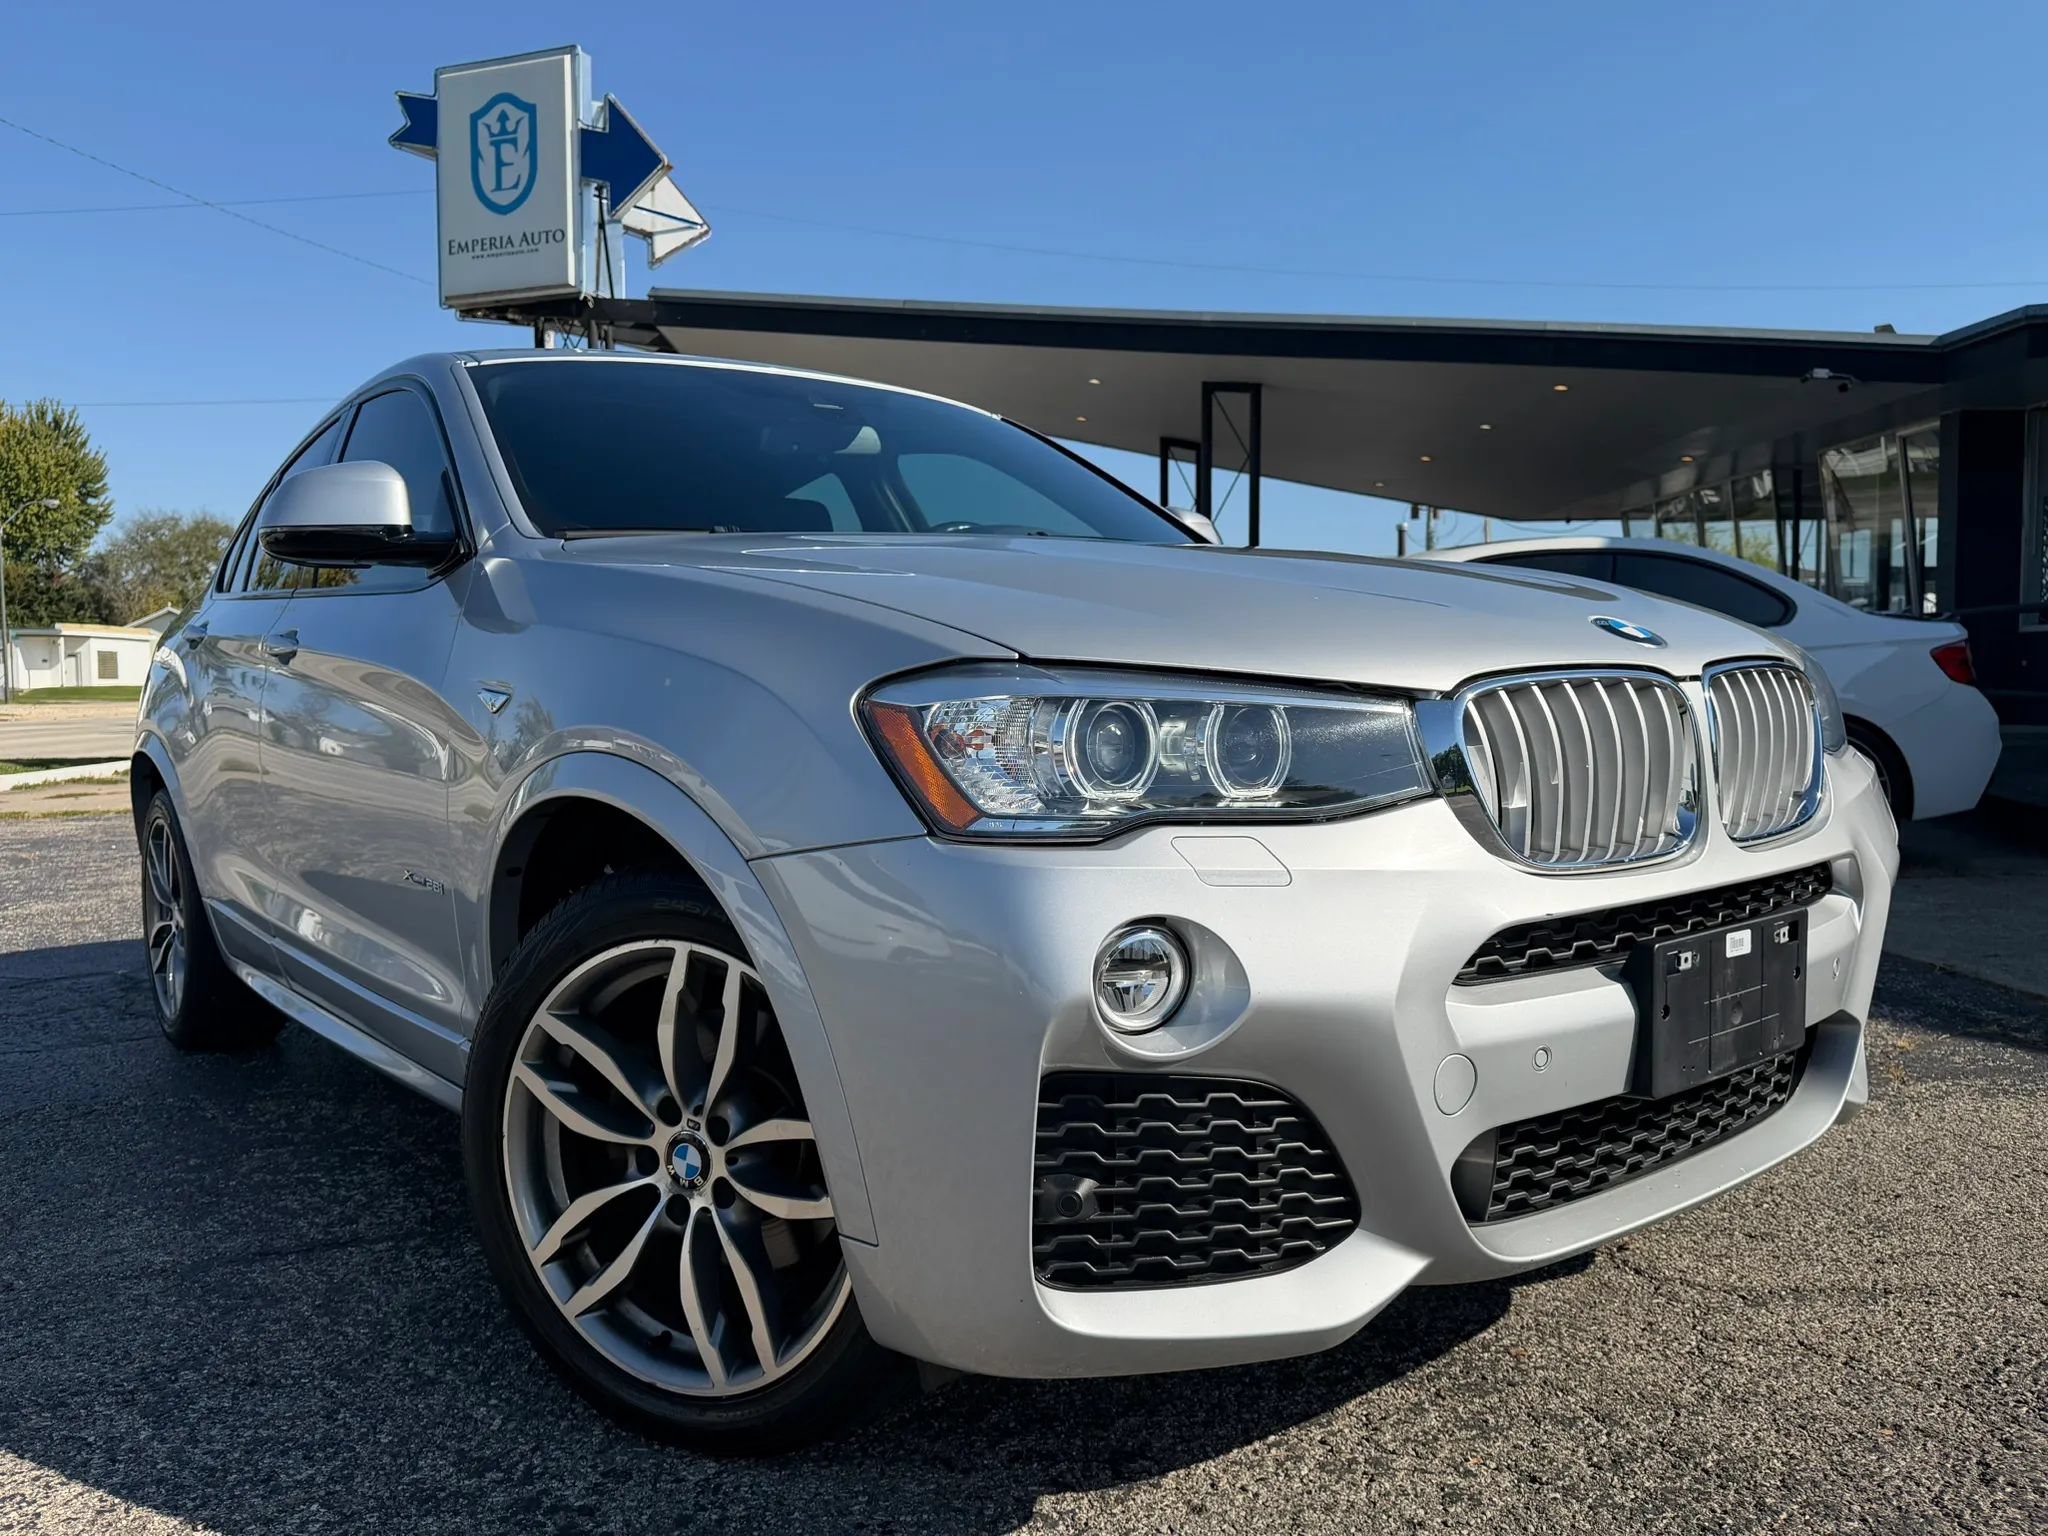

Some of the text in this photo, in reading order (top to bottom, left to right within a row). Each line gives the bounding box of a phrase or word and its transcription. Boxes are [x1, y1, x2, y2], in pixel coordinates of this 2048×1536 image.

[489, 137, 521, 192] E
[448, 228, 566, 256] EMPERIA AUTO
